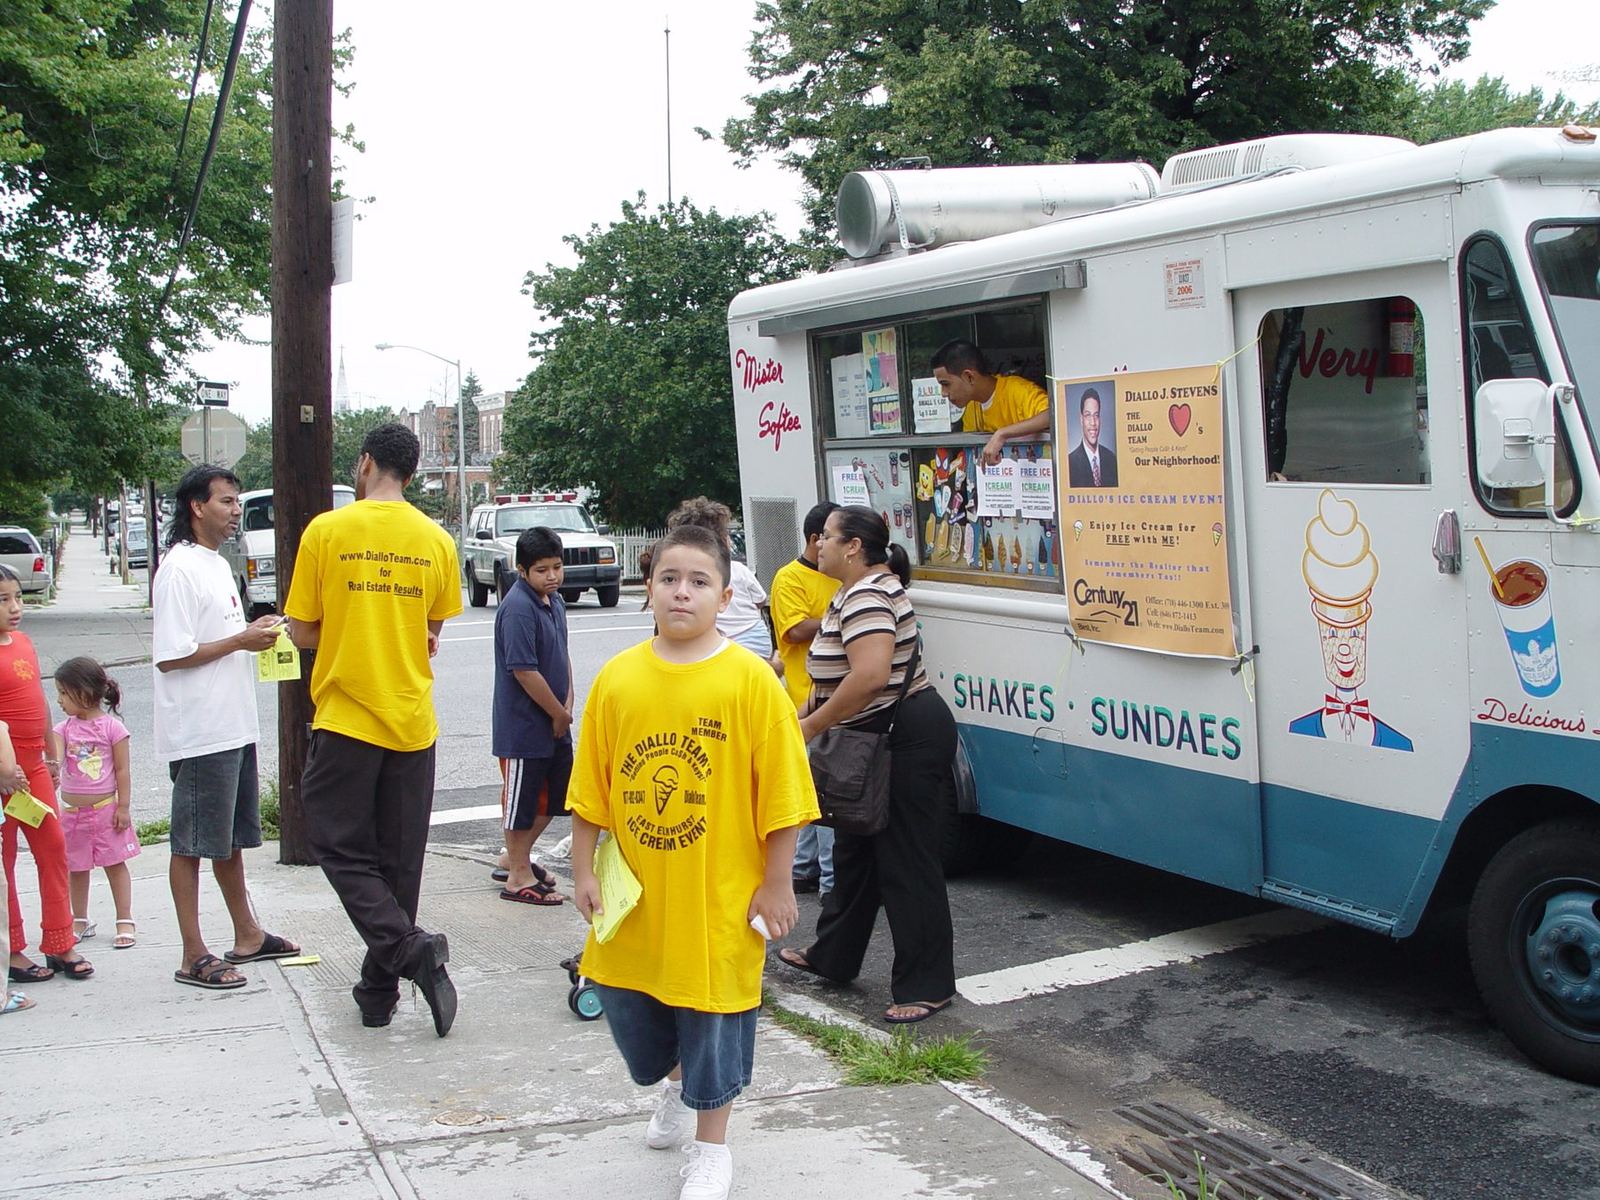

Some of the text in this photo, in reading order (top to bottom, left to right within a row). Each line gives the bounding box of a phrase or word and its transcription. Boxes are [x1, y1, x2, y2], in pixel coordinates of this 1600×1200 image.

[1177, 285, 1193, 295] 2006
[1299, 327, 1378, 394] Very
[736, 349, 783, 393] Mister
[1125, 385, 1218, 402] DIALLO J. STEVENS
[1126, 412, 1140, 420] THE
[759, 401, 801, 451] Softee
[1128, 423, 1152, 432] DIALLO
[1128, 436, 1147, 444] TEAM
[1135, 455, 1220, 468] Our Neighborhood!
[1002, 467, 1013, 475] ICE
[1021, 468, 1051, 476] FREE ICE
[1068, 495, 1114, 504] DIALLO'S
[1118, 495, 1135, 504] ICE
[1140, 495, 1177, 504] CREAM
[1090, 521, 1196, 532] Enjoy Ice Cream for
[1106, 535, 1179, 546] FREE with ME!
[340, 550, 431, 567] www.DialloTeam.com
[380, 567, 391, 577] for
[1130, 560, 1144, 569] the
[1187, 564, 1210, 572] that
[367, 582, 391, 592] Estate
[394, 583, 423, 596] Results
[1074, 578, 1125, 608] Century
[1122, 601, 1139, 627] 21
[953, 672, 1055, 722] SHAKES
[1478, 698, 1585, 732] Delicious
[698, 717, 722, 730] TEAM
[1091, 696, 1241, 760] SUNDAES
[692, 728, 728, 742] MEMBER
[620, 732, 712, 778] THE DIALLO TEAM'S
[645, 748, 669, 760] People
[636, 815, 656, 832] EAST
[627, 817, 641, 839] ICE
[678, 816, 707, 848] EVENT
